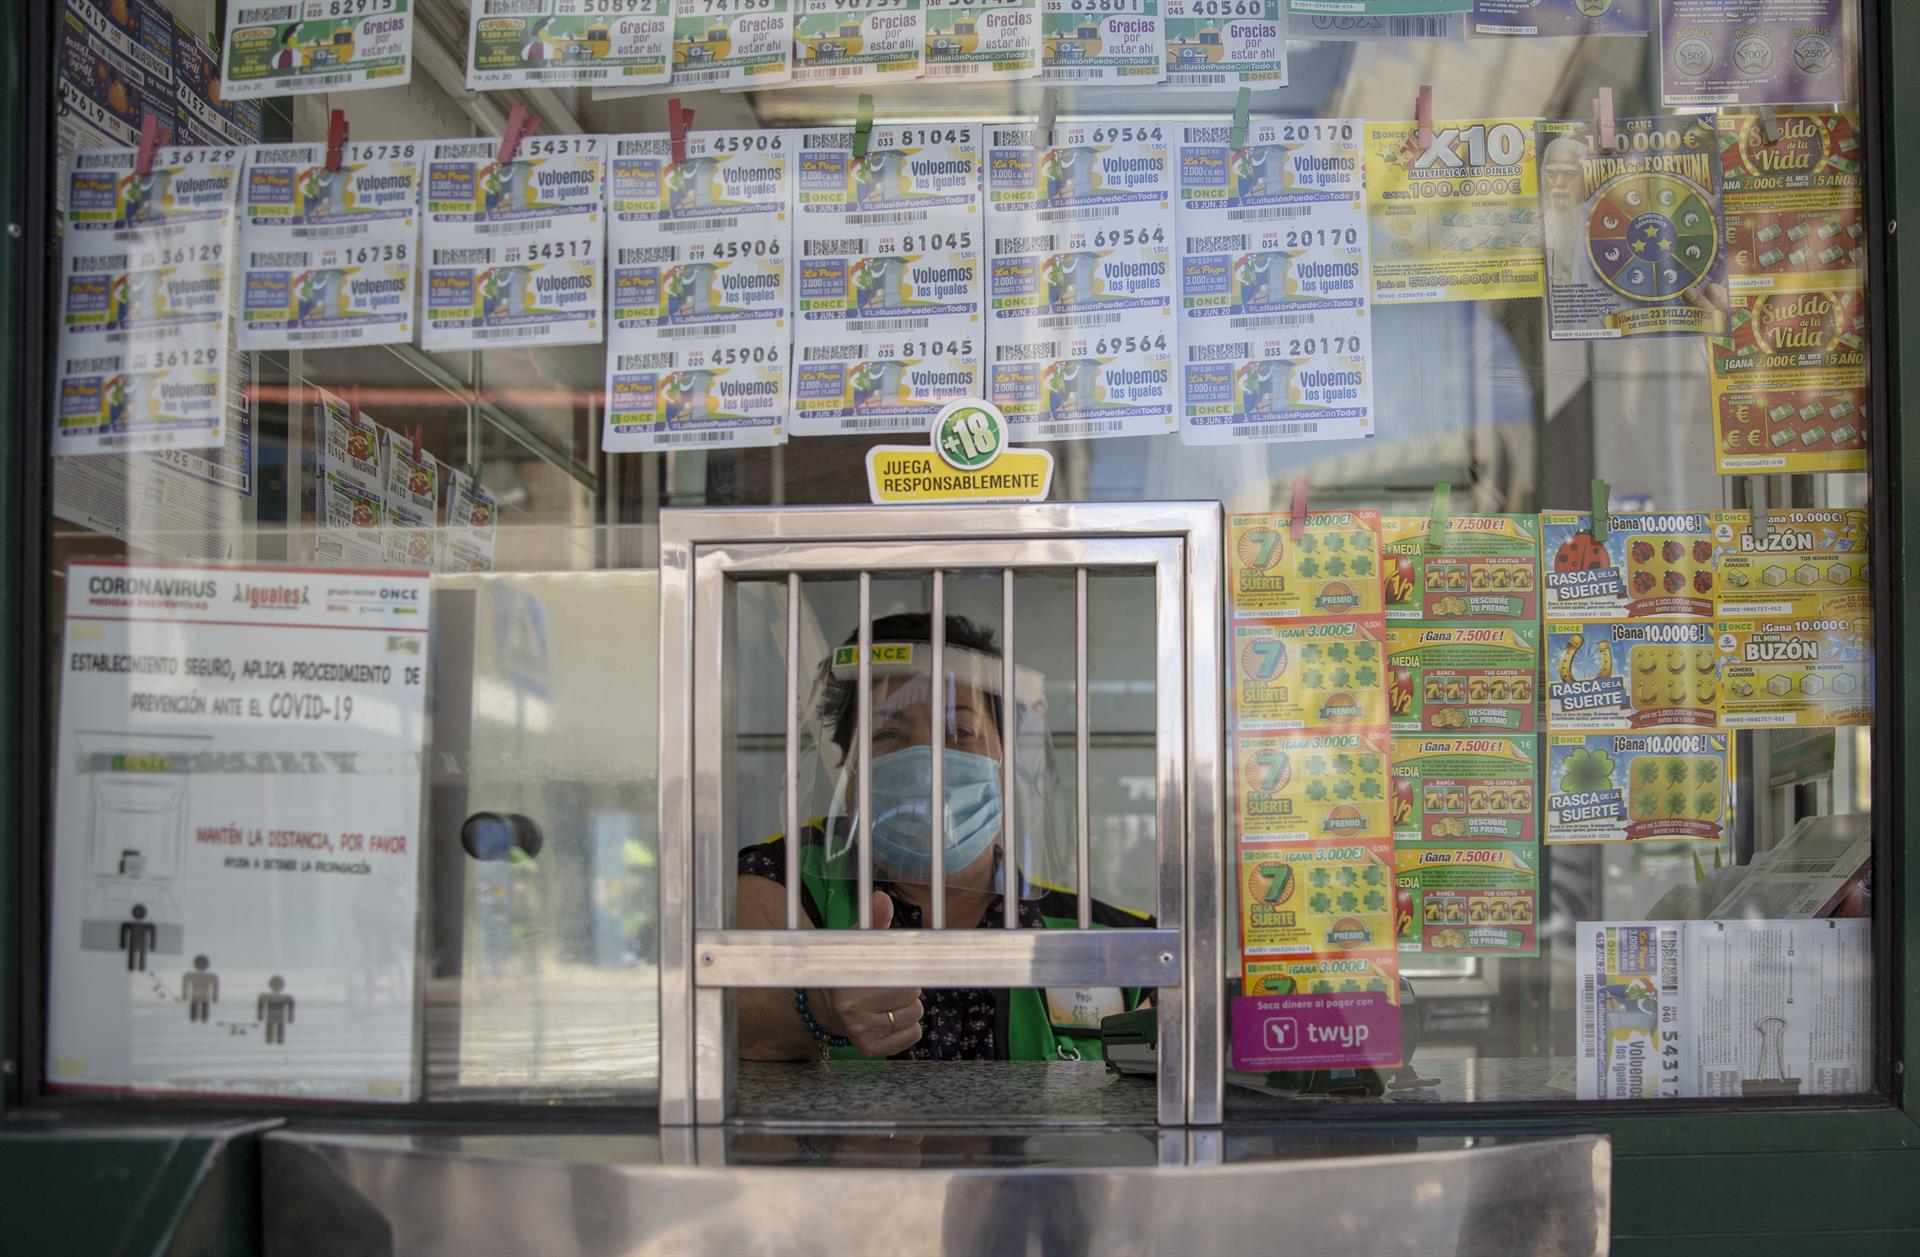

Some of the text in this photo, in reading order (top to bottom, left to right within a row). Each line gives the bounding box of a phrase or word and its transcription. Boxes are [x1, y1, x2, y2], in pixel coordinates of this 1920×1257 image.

[1168, 0, 1261, 15] 045 40560
[620, 21, 665, 35] Gracias
[740, 17, 784, 32] Gracias
[986, 13, 1032, 27] Gracias
[1109, 20, 1155, 33] Gracias
[1123, 34, 1140, 43] por
[1231, 25, 1276, 38] Gracias
[1675, 27, 1711, 37] BONUS
[633, 35, 649, 45] por
[738, 42, 764, 54] estar
[1246, 39, 1262, 49] por
[1110, 43, 1153, 54] estar ahí
[1232, 49, 1258, 60] estar
[1259, 125, 1353, 141] 033 20170
[1627, 120, 1653, 131] GANA
[714, 136, 782, 151] 45906
[878, 129, 970, 146] 033 81045
[1068, 127, 1162, 144] 033 69564
[352, 145, 415, 160] 16738
[530, 139, 597, 156] 54317
[1414, 124, 1525, 168] X10
[170, 151, 235, 165] 36129
[1294, 155, 1355, 172] Volvemos
[1756, 149, 1809, 171] Vida
[1299, 172, 1351, 187] los iguales
[1409, 166, 1522, 178] MULTIPLICA EL DINERO
[1583, 153, 1714, 200] RUEDA FORTUNA
[1410, 179, 1521, 197] 100.000€
[1744, 176, 1783, 189] 2.000€
[879, 232, 971, 253] 034 81045
[1070, 227, 1164, 248] 034 69564
[1262, 228, 1357, 248] 034 20170
[162, 244, 223, 264] 36129
[346, 244, 407, 264] 16738
[528, 240, 592, 260] 54317
[713, 239, 780, 258] 45906
[913, 267, 973, 284] Volvemos
[1104, 262, 1166, 278] Volvemos
[1297, 262, 1358, 279] Volvemos
[918, 284, 968, 299] los iguales
[1109, 278, 1160, 293] los iguales
[1650, 305, 1712, 318] 23 MILLONES
[1761, 295, 1830, 325] Sueldo
[1071, 335, 1167, 356] 035 69564
[1770, 327, 1822, 348] Vida
[878, 340, 972, 358] 035 81045
[1265, 336, 1360, 357] 035 20170
[155, 348, 217, 367] 36129
[688, 347, 778, 366] 020 45906
[1725, 355, 1796, 370] ¡GANA 2.000€
[1300, 370, 1362, 387] Volvemos
[944, 412, 998, 459] +18
[884, 460, 932, 475] JUEGA
[884, 474, 1039, 492] RESPONSABLEMENTE
[1523, 519, 1534, 528] 1€
[1608, 516, 1638, 533] ¡Gana
[1789, 513, 1843, 523] 10.000€!
[1251, 531, 1281, 567] 7
[1393, 544, 1421, 555] MEDIA
[1241, 577, 1282, 591] SUERTE
[1549, 571, 1597, 585] RASCA
[88, 576, 217, 599] CORONAVIRUS
[245, 583, 300, 608] iguales
[380, 588, 419, 600] ONCE
[1560, 581, 1619, 599] SUERTE
[1322, 596, 1352, 604] PREMIO
[1470, 597, 1509, 605] DESCUBRE
[1613, 625, 1643, 642] ¡Gana
[1794, 621, 1849, 632] 10.000€!
[1746, 638, 1818, 661] BUZÓN
[1253, 641, 1285, 678] 7
[1392, 656, 1420, 667] MEDIA
[71, 654, 420, 685] ESTABLECIMIENTO SEGURO, APLICA PROCEDIMIENTO DE
[1553, 682, 1601, 696] RASCA
[131, 690, 354, 721] PREVENCIÓN ANTE EL COVID-19
[1564, 692, 1622, 710] SUERTE
[1326, 707, 1356, 716] PREMIO
[1614, 736, 1644, 752] ¡Gana
[1552, 794, 1599, 808] RASCA
[1562, 804, 1619, 821] SUERTE
[1330, 819, 1360, 828] PREMIO
[196, 822, 407, 854] MANTÉN LA DISTANCIA, POR FAVOR
[224, 857, 250, 869] AYUDA
[301, 862, 312, 872] LA
[315, 860, 372, 875] PROPAGACIÓN
[1334, 932, 1364, 940] PREMIO
[1289, 960, 1368, 974] ¡GANA 3.000€!
[1257, 1001, 1280, 1010] Saca
[1282, 1001, 1312, 1009] dinero
[1327, 999, 1352, 1009] pagar
[1357, 998, 1373, 1006] con
[1307, 1023, 1369, 1047] twyp
[1662, 1031, 1678, 1097] 54317
